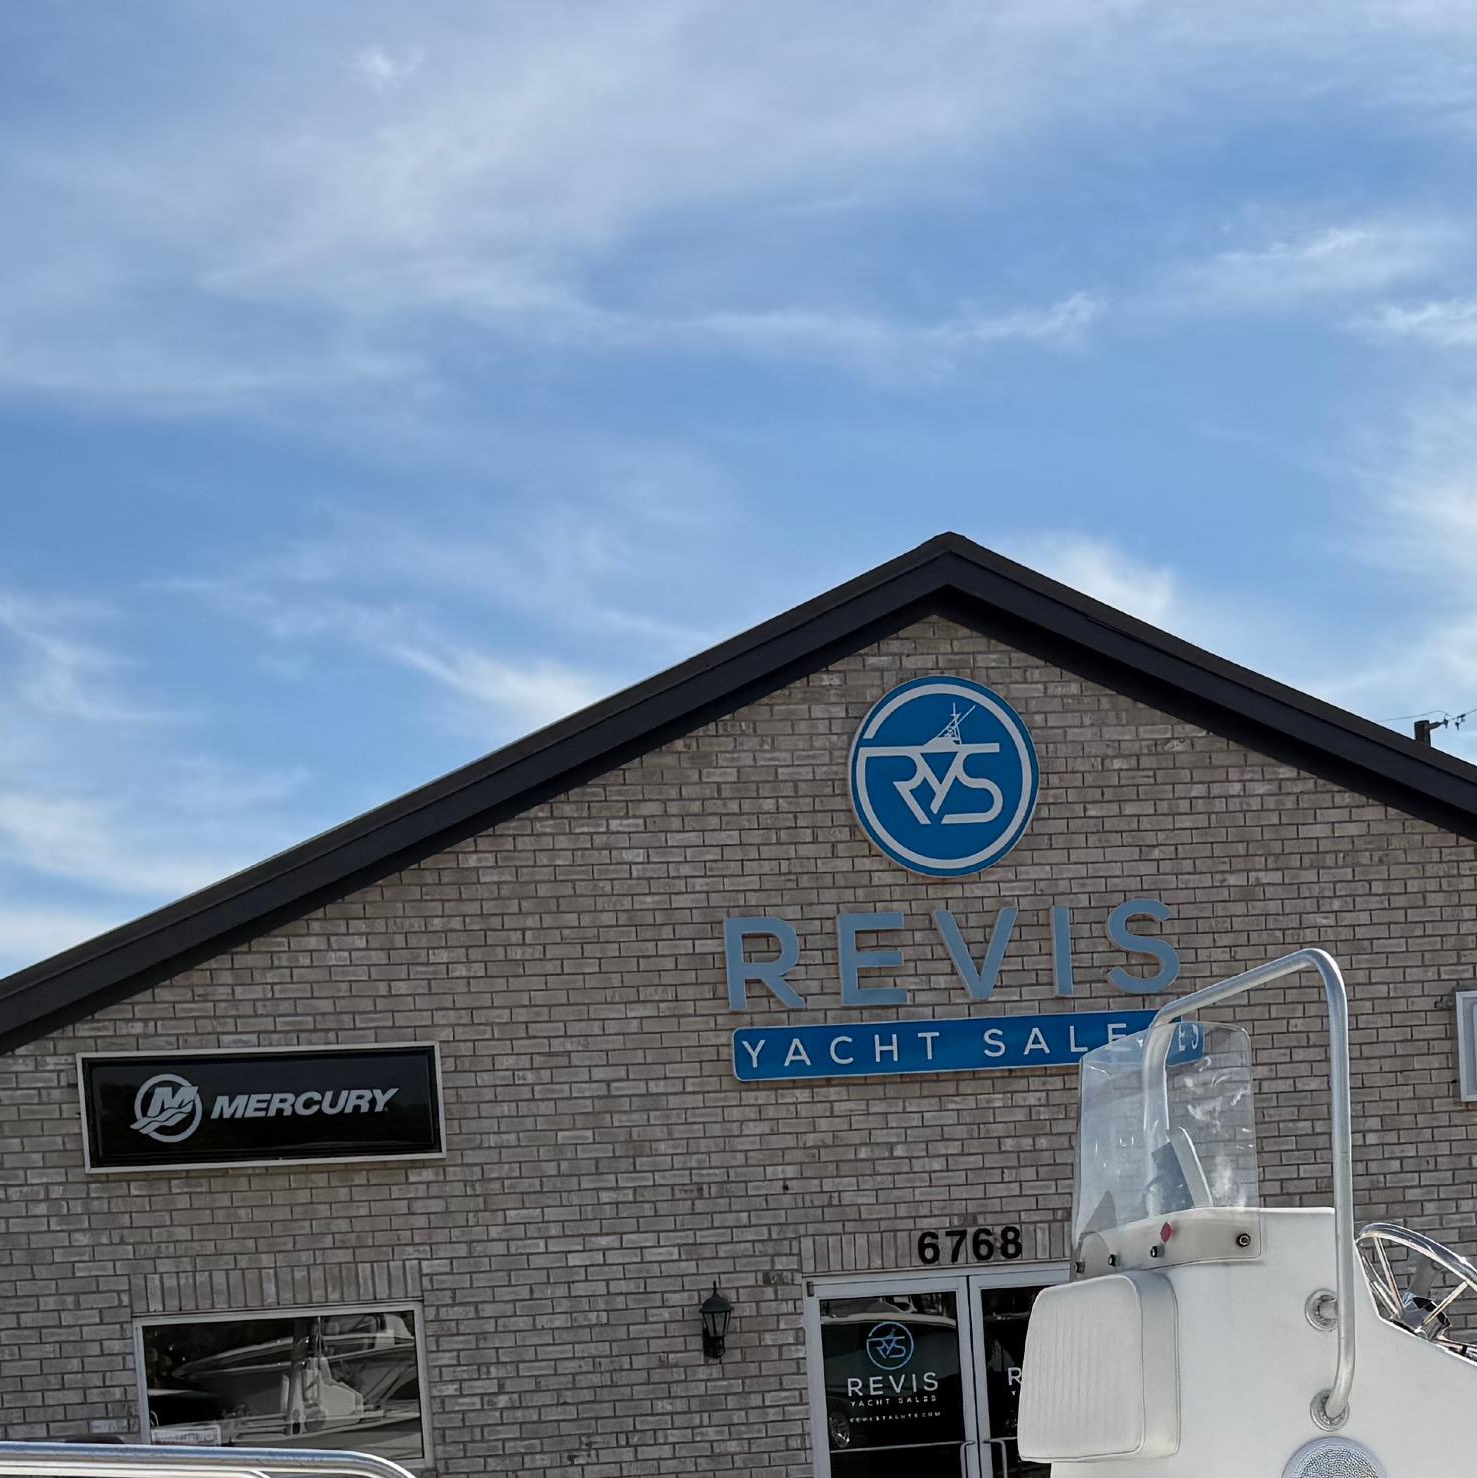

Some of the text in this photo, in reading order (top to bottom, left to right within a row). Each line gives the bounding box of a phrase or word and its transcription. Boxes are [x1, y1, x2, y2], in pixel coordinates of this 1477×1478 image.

[723, 900, 1181, 1011] REVIS
[741, 1032, 941, 1069] YACHT
[210, 1087, 400, 1120] MERCURY
[918, 1226, 1022, 1265] 6768
[847, 1372, 939, 1397] REVIS
[850, 1398, 890, 1408] YACHT
